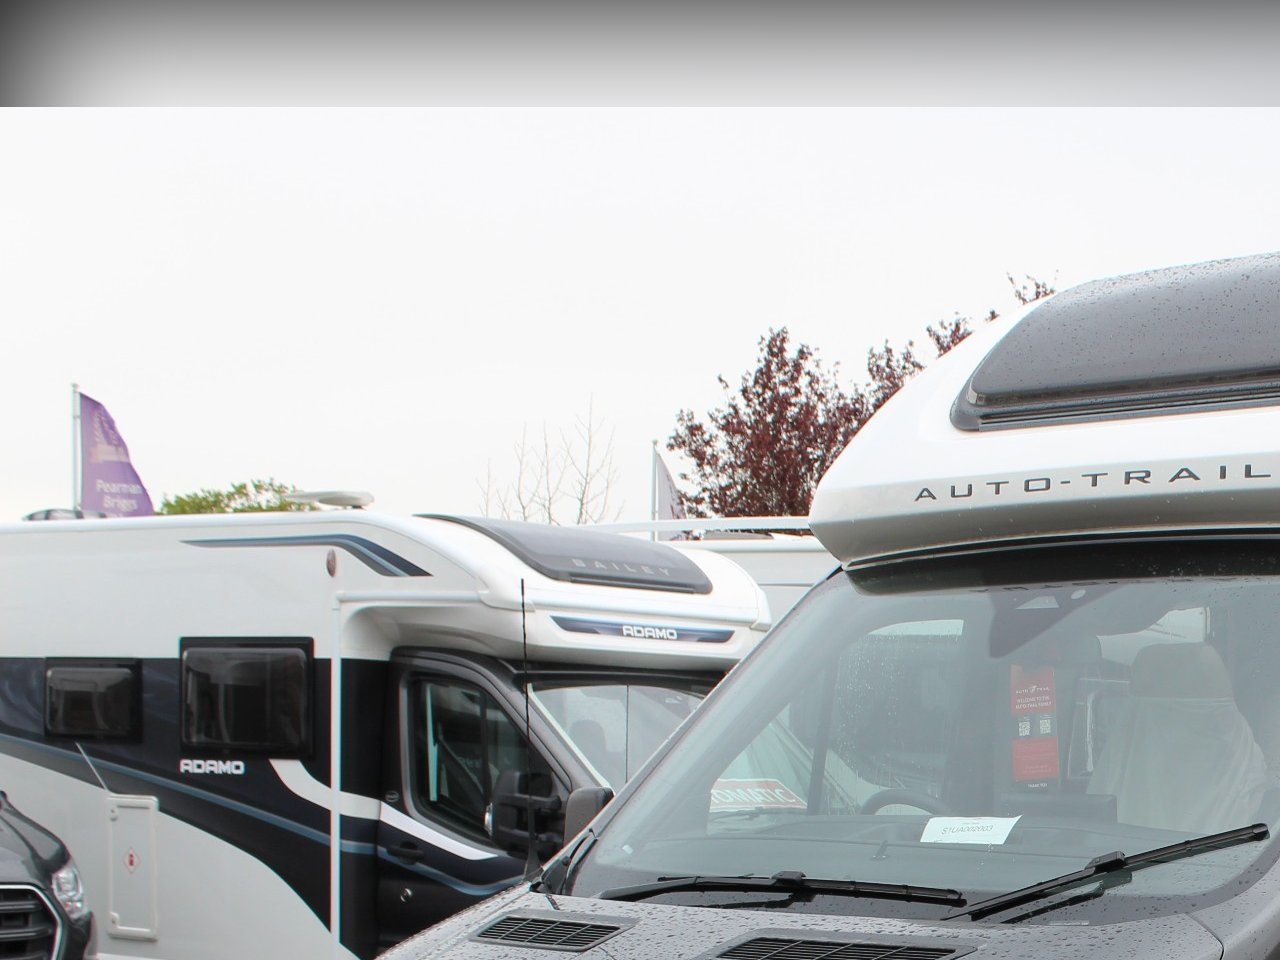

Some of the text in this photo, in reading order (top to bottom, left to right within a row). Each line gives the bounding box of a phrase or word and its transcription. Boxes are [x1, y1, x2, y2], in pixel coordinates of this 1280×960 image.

[914, 463, 1272, 502] AUTO-TRAIL
[571, 558, 669, 576] BAILEY
[622, 625, 678, 640] ADAMO
[180, 759, 245, 775] ADAMO
